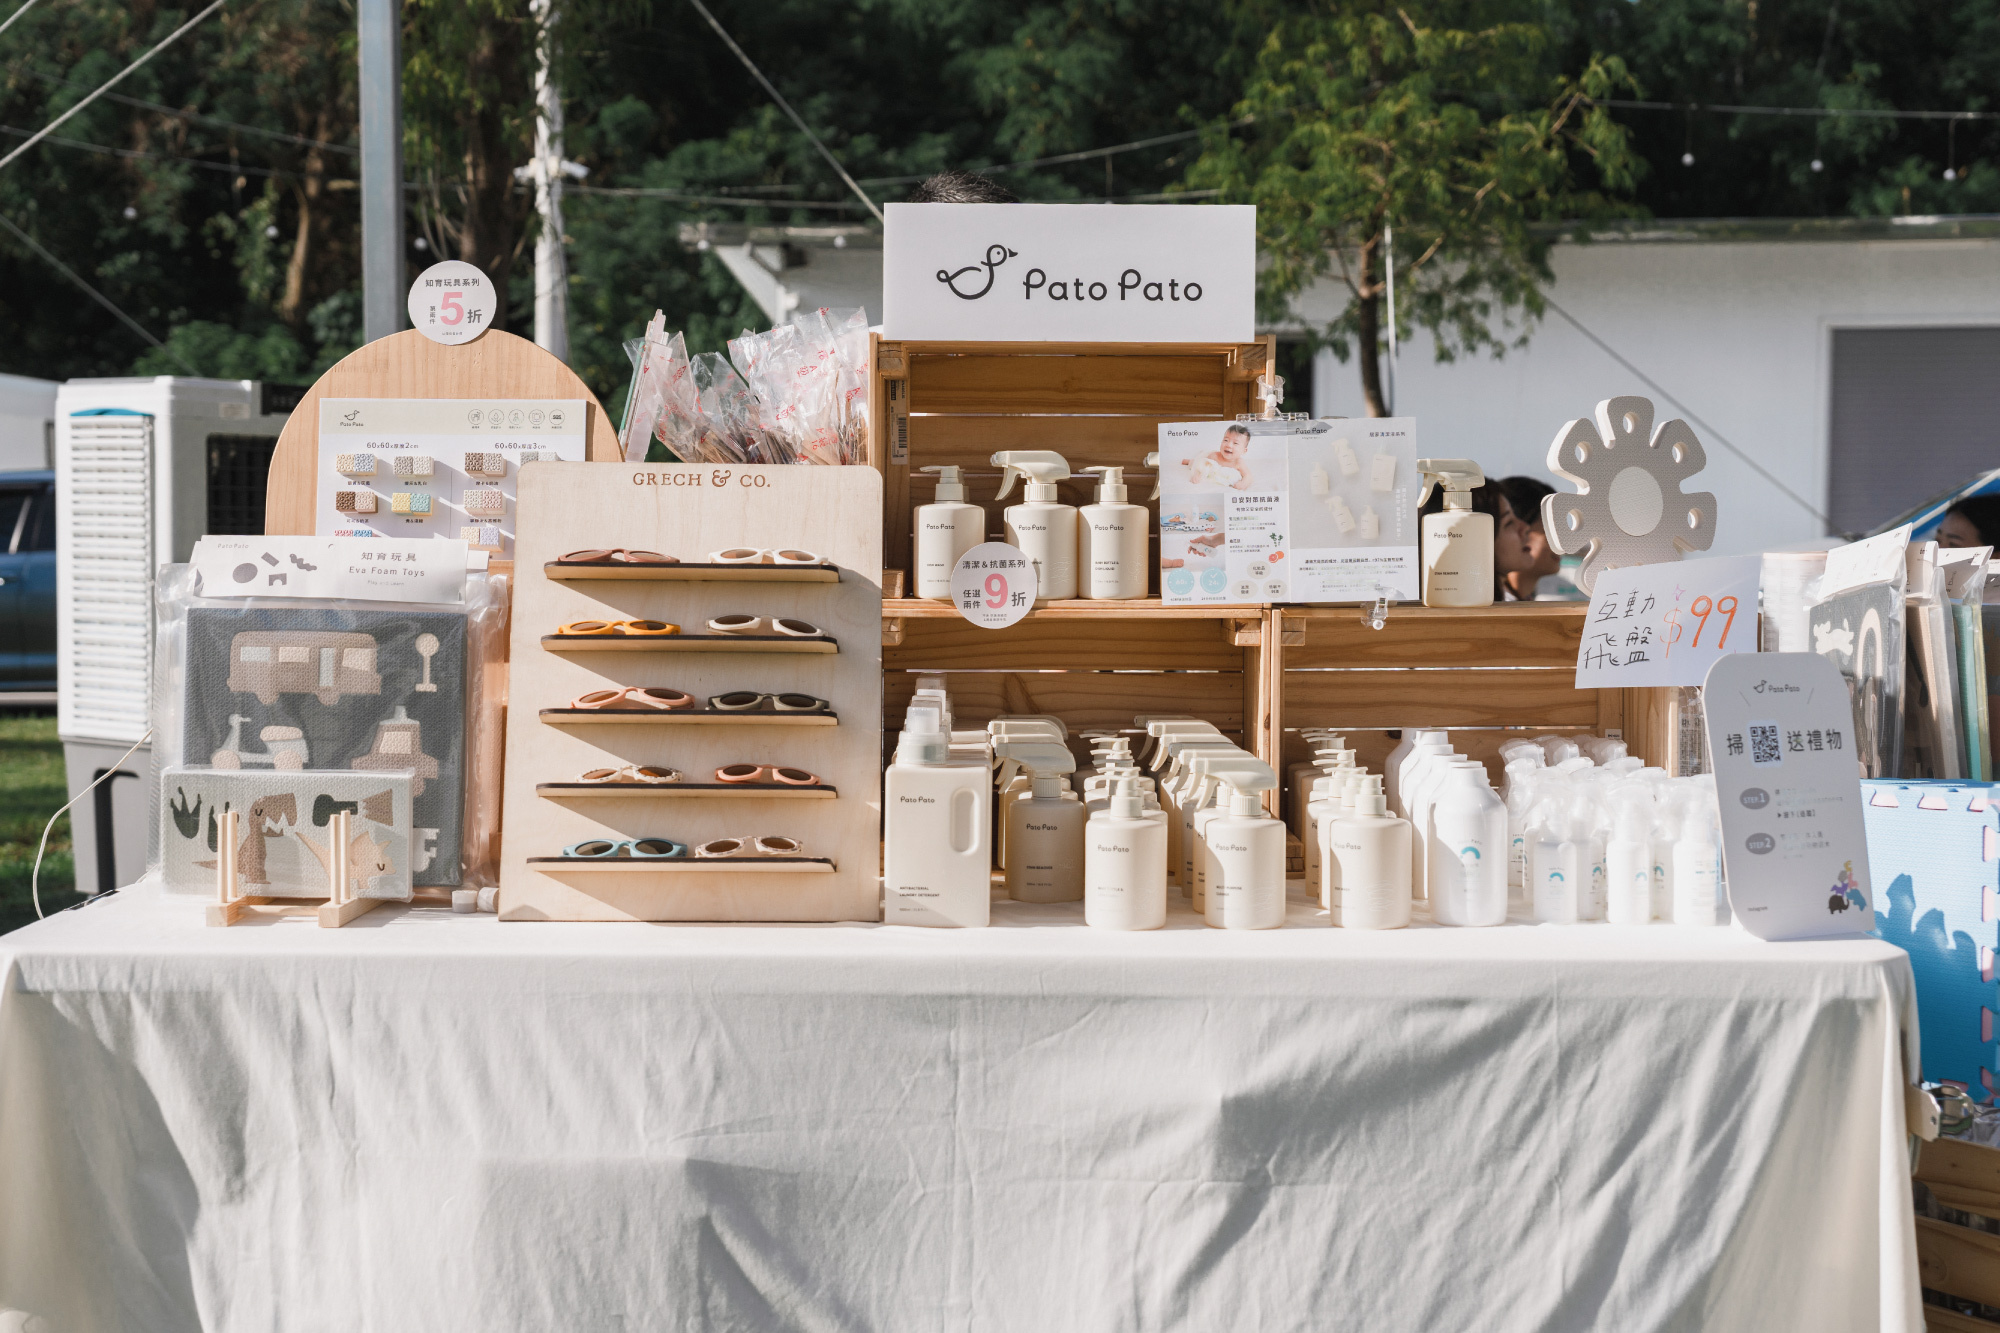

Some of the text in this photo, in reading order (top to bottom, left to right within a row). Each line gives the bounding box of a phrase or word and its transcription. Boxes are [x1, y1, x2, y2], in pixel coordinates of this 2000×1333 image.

[425, 278, 480, 287] 知育玩具系列
[1023, 268, 1203, 301] Pato Pato
[440, 291, 482, 325] 5 折
[1183, 429, 1198, 437] Pato
[632, 469, 771, 488] GRECH & CO.
[361, 552, 417, 562] 知育玩具
[349, 566, 425, 577] Eva Foam Toys
[963, 590, 981, 598] 任選
[984, 573, 1026, 609] 9 折
[963, 600, 981, 609] 兩件
[1594, 587, 1655, 623] 互動
[1659, 595, 1738, 659] $99
[1726, 733, 1744, 756] 掃
[1786, 728, 1842, 753] 送禮物
[1026, 823, 1057, 831] Pato Pato
[1097, 844, 1129, 853] Pato Pato
[1230, 844, 1247, 852] Pato
[1346, 842, 1361, 850] Pato
